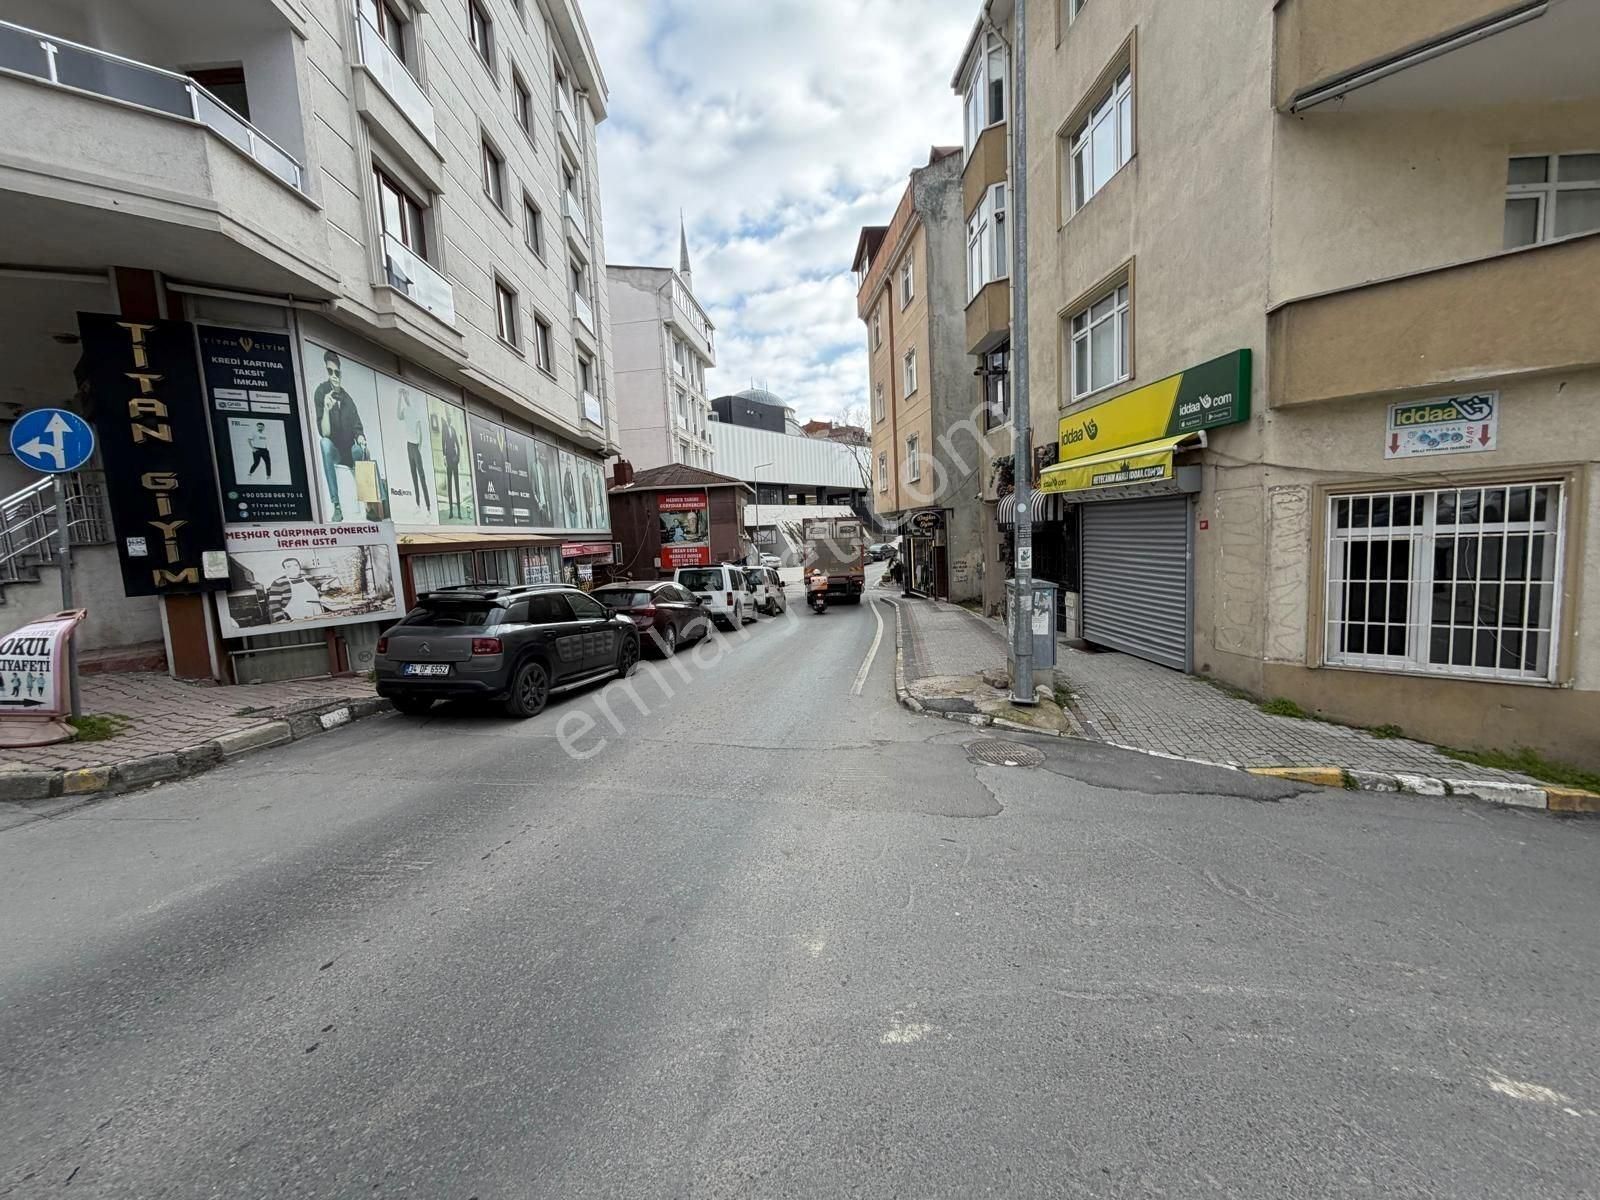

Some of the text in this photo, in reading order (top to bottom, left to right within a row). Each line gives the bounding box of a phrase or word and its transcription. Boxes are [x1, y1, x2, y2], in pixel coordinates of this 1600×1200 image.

[212, 356, 283, 369] KREDİ KARTINA
[233, 368, 265, 377] TAKSİT
[233, 378, 268, 388] İMKANI
[1179, 393, 1232, 416] iddaa com
[1396, 406, 1457, 425] iddaa
[1061, 427, 1083, 446] iddaa
[225, 524, 379, 541] MEŞHUR GÜRPINAR DÖNERCİSİ
[277, 538, 337, 548] İRFAN USTA
[0, 637, 51, 656] OKUL
